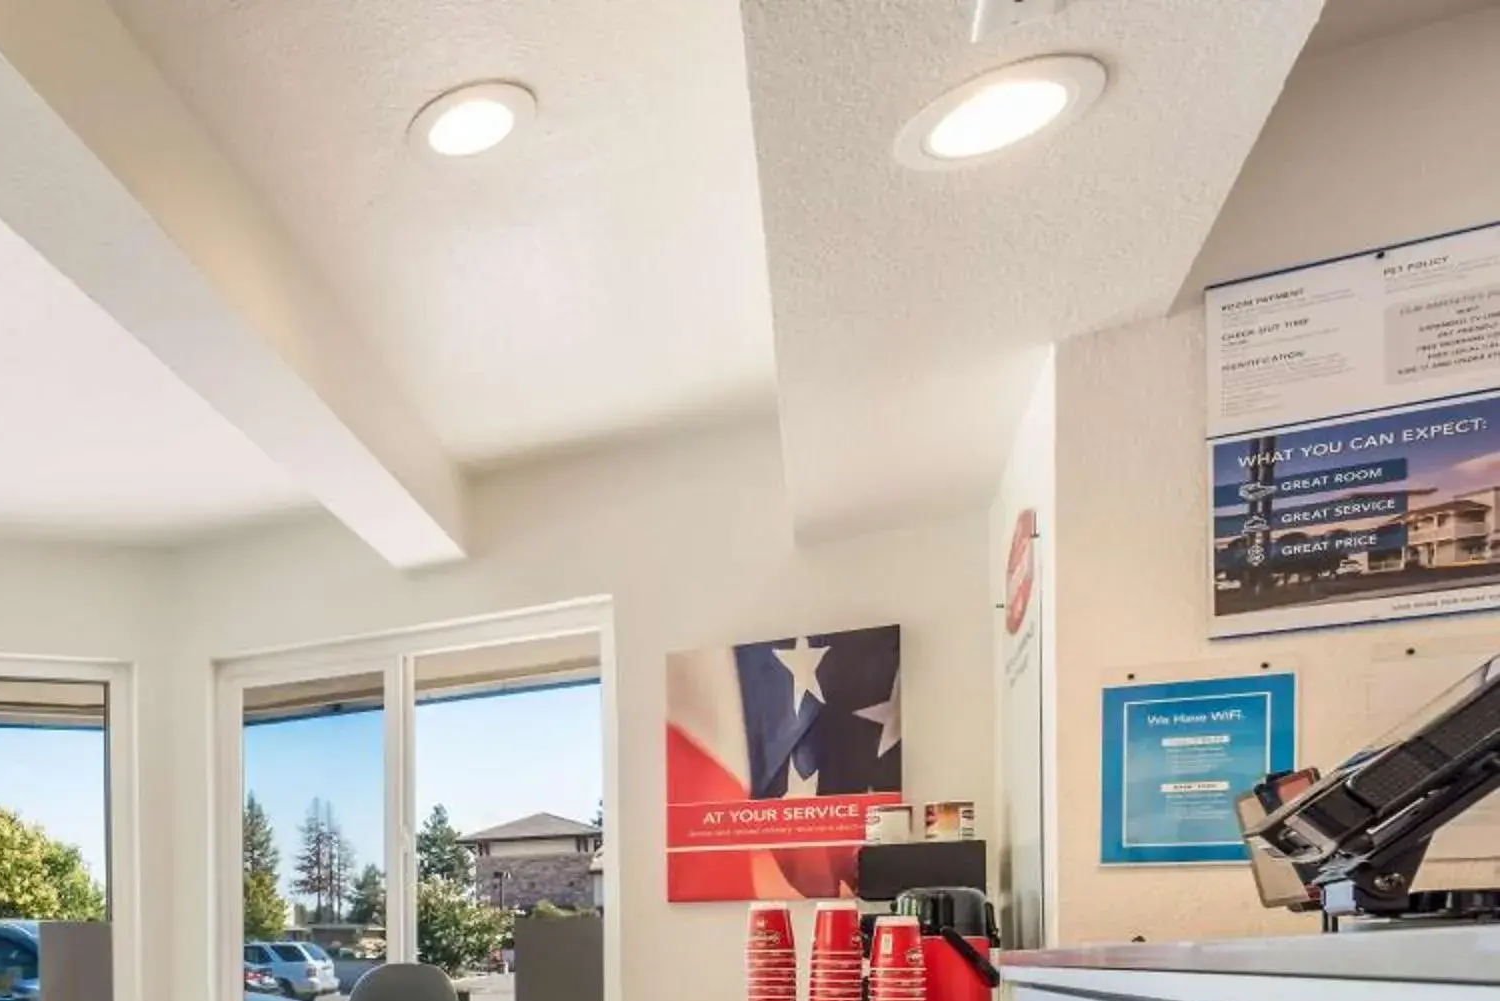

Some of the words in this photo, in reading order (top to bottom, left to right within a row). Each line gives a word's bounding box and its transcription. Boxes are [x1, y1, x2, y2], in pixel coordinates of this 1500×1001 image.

[1237, 448, 1293, 468] WHAT
[1301, 441, 1342, 458] YOU
[1350, 432, 1395, 450] CAN
[1402, 416, 1488, 442] EXPECT:
[1281, 476, 1328, 492] GREAT
[1334, 467, 1382, 483] ROOM
[1281, 508, 1329, 524] GREAT
[1333, 499, 1396, 517] SERVICE
[1281, 541, 1329, 556] GREAT
[1335, 534, 1378, 549] PRICE
[1148, 714, 1170, 726] We
[1174, 712, 1207, 725] Have
[702, 811, 725, 825] AT
[730, 808, 778, 824] YOUR
[783, 803, 859, 821] SERVICE
